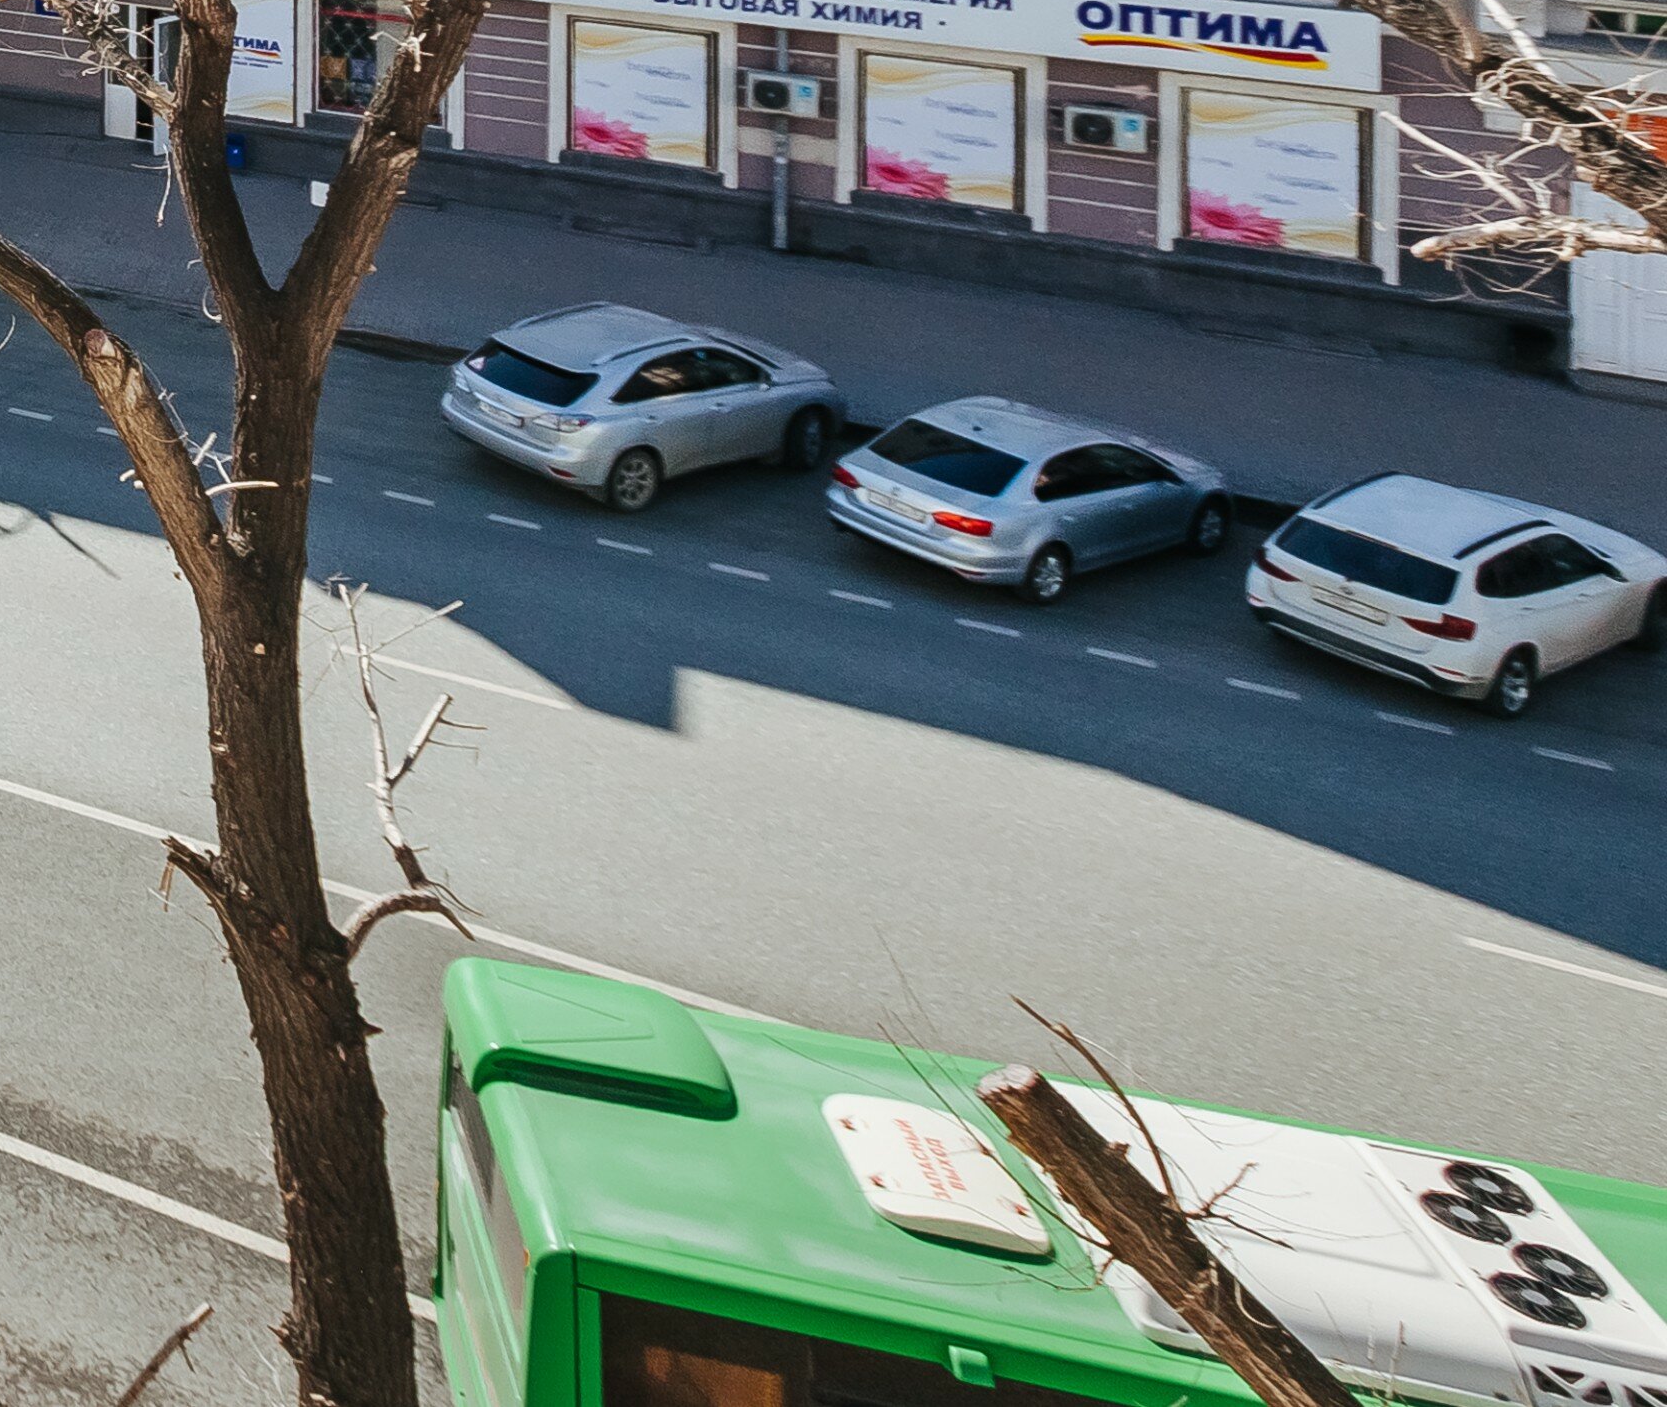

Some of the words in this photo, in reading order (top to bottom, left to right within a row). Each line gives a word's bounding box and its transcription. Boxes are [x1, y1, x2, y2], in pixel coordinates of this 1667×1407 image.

[811, 0, 924, 31] ХИМИЯ
[1077, 0, 1329, 53] ОПТИМА
[923, 1137, 968, 1192] ВЫХОД
